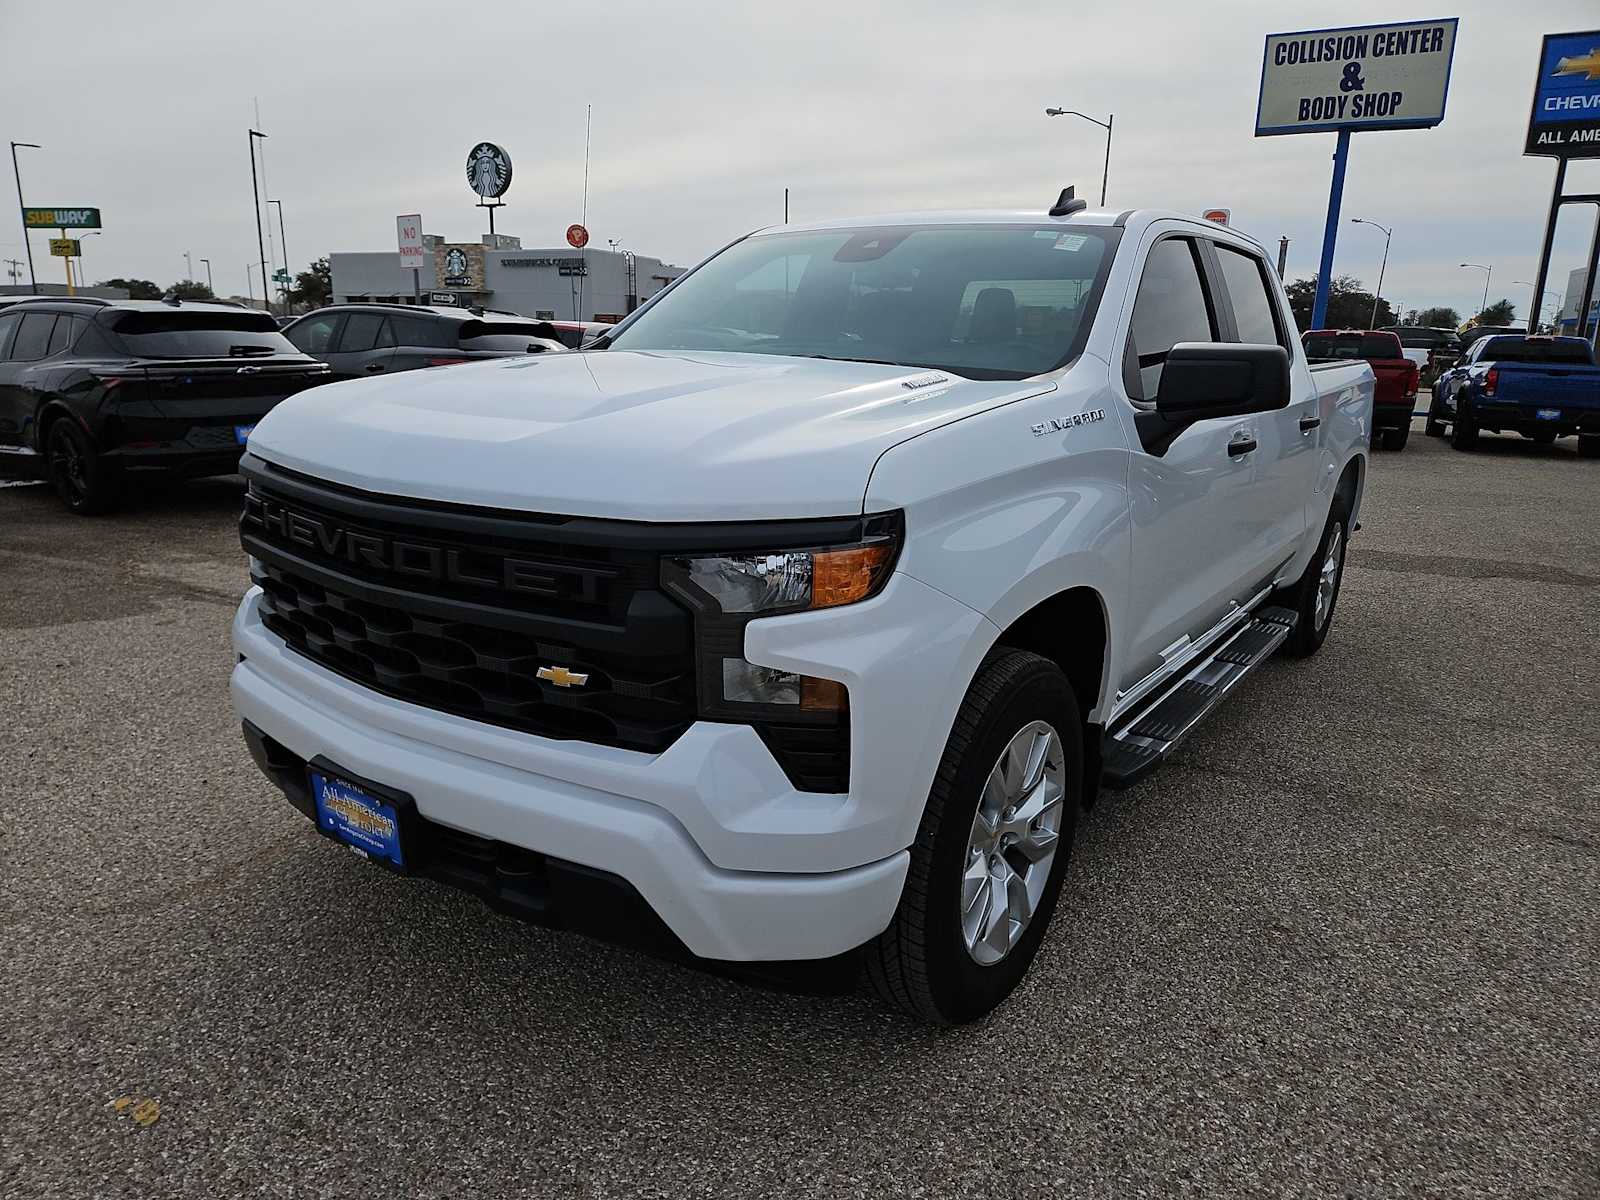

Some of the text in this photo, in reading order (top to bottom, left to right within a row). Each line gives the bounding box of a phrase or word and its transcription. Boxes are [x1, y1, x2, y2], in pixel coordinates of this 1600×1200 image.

[1275, 27, 1445, 66] COLLISION CENTER
[1340, 62, 1366, 92] &
[1298, 91, 1403, 121] BODY SHOP
[1537, 131, 1565, 145] ALL
[26, 210, 88, 225] SUBWAY
[403, 227, 416, 240] NO
[400, 246, 424, 257] PARKING
[1031, 408, 1107, 437] SILVERADO
[242, 491, 625, 602] CHEVROLET
[322, 785, 339, 802] All
[343, 794, 395, 830] American
